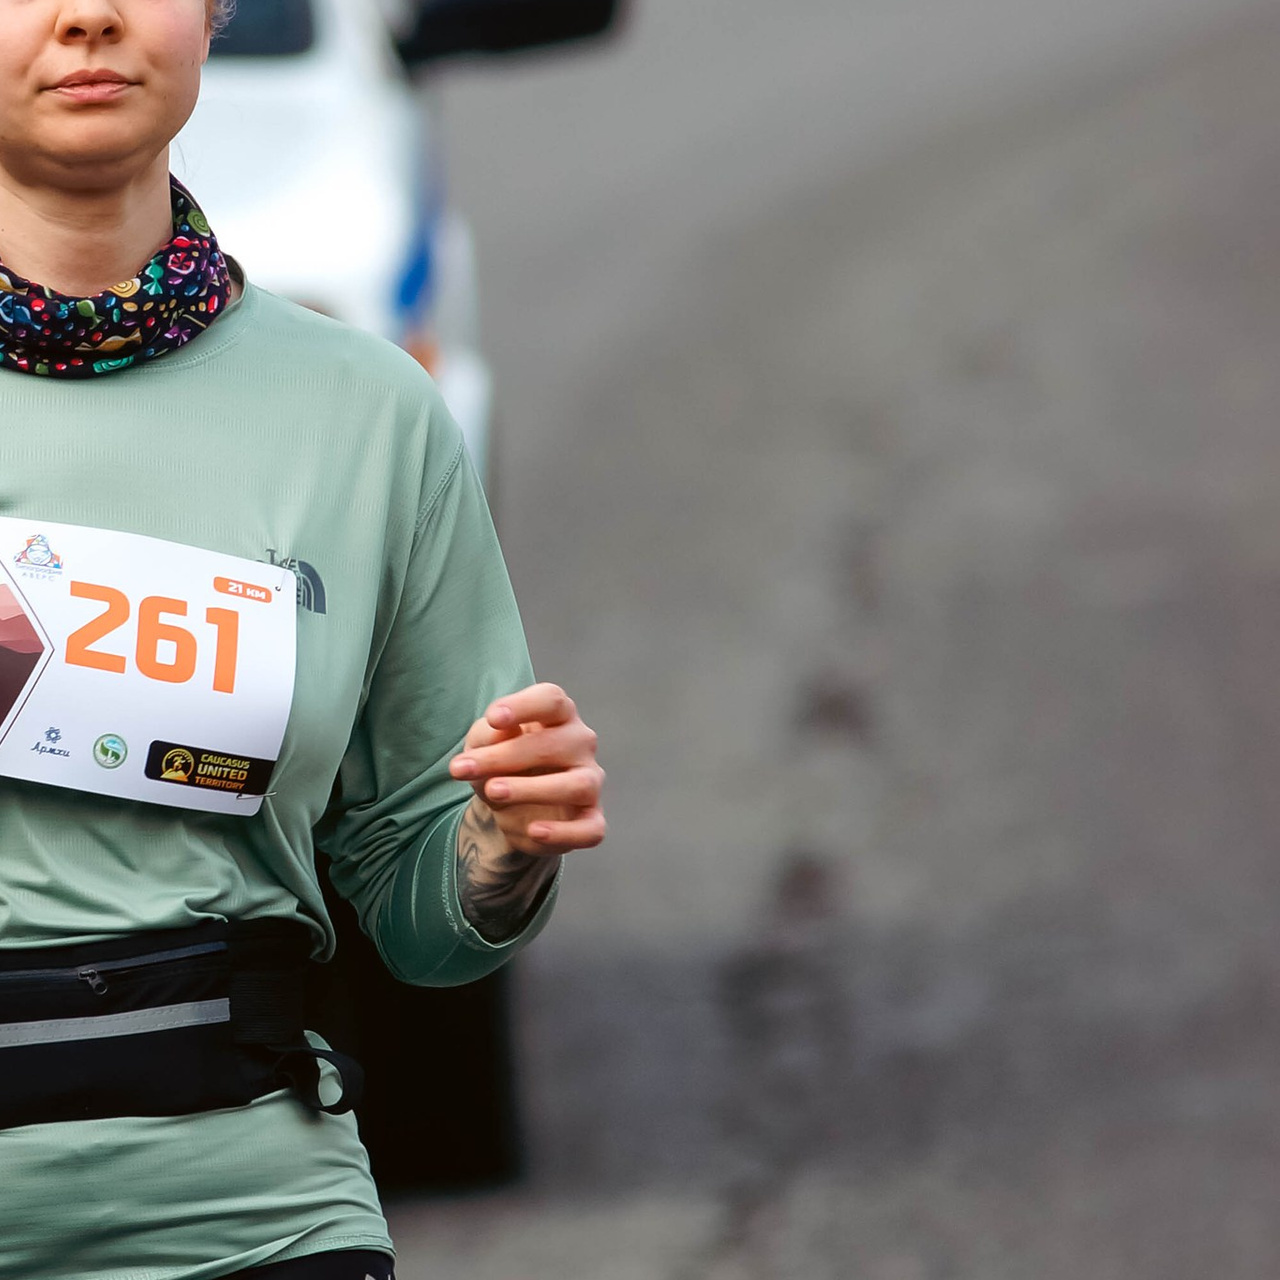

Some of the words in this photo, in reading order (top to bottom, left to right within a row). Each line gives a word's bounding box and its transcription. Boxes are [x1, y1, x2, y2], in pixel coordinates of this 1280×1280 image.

[227, 581, 244, 594] 21
[65, 580, 239, 694] 261
[30, 741, 71, 758] Армхи
[200, 753, 251, 770] CAUCASUS
[197, 763, 249, 781] UNITED
[194, 775, 246, 790] TERRITORY
